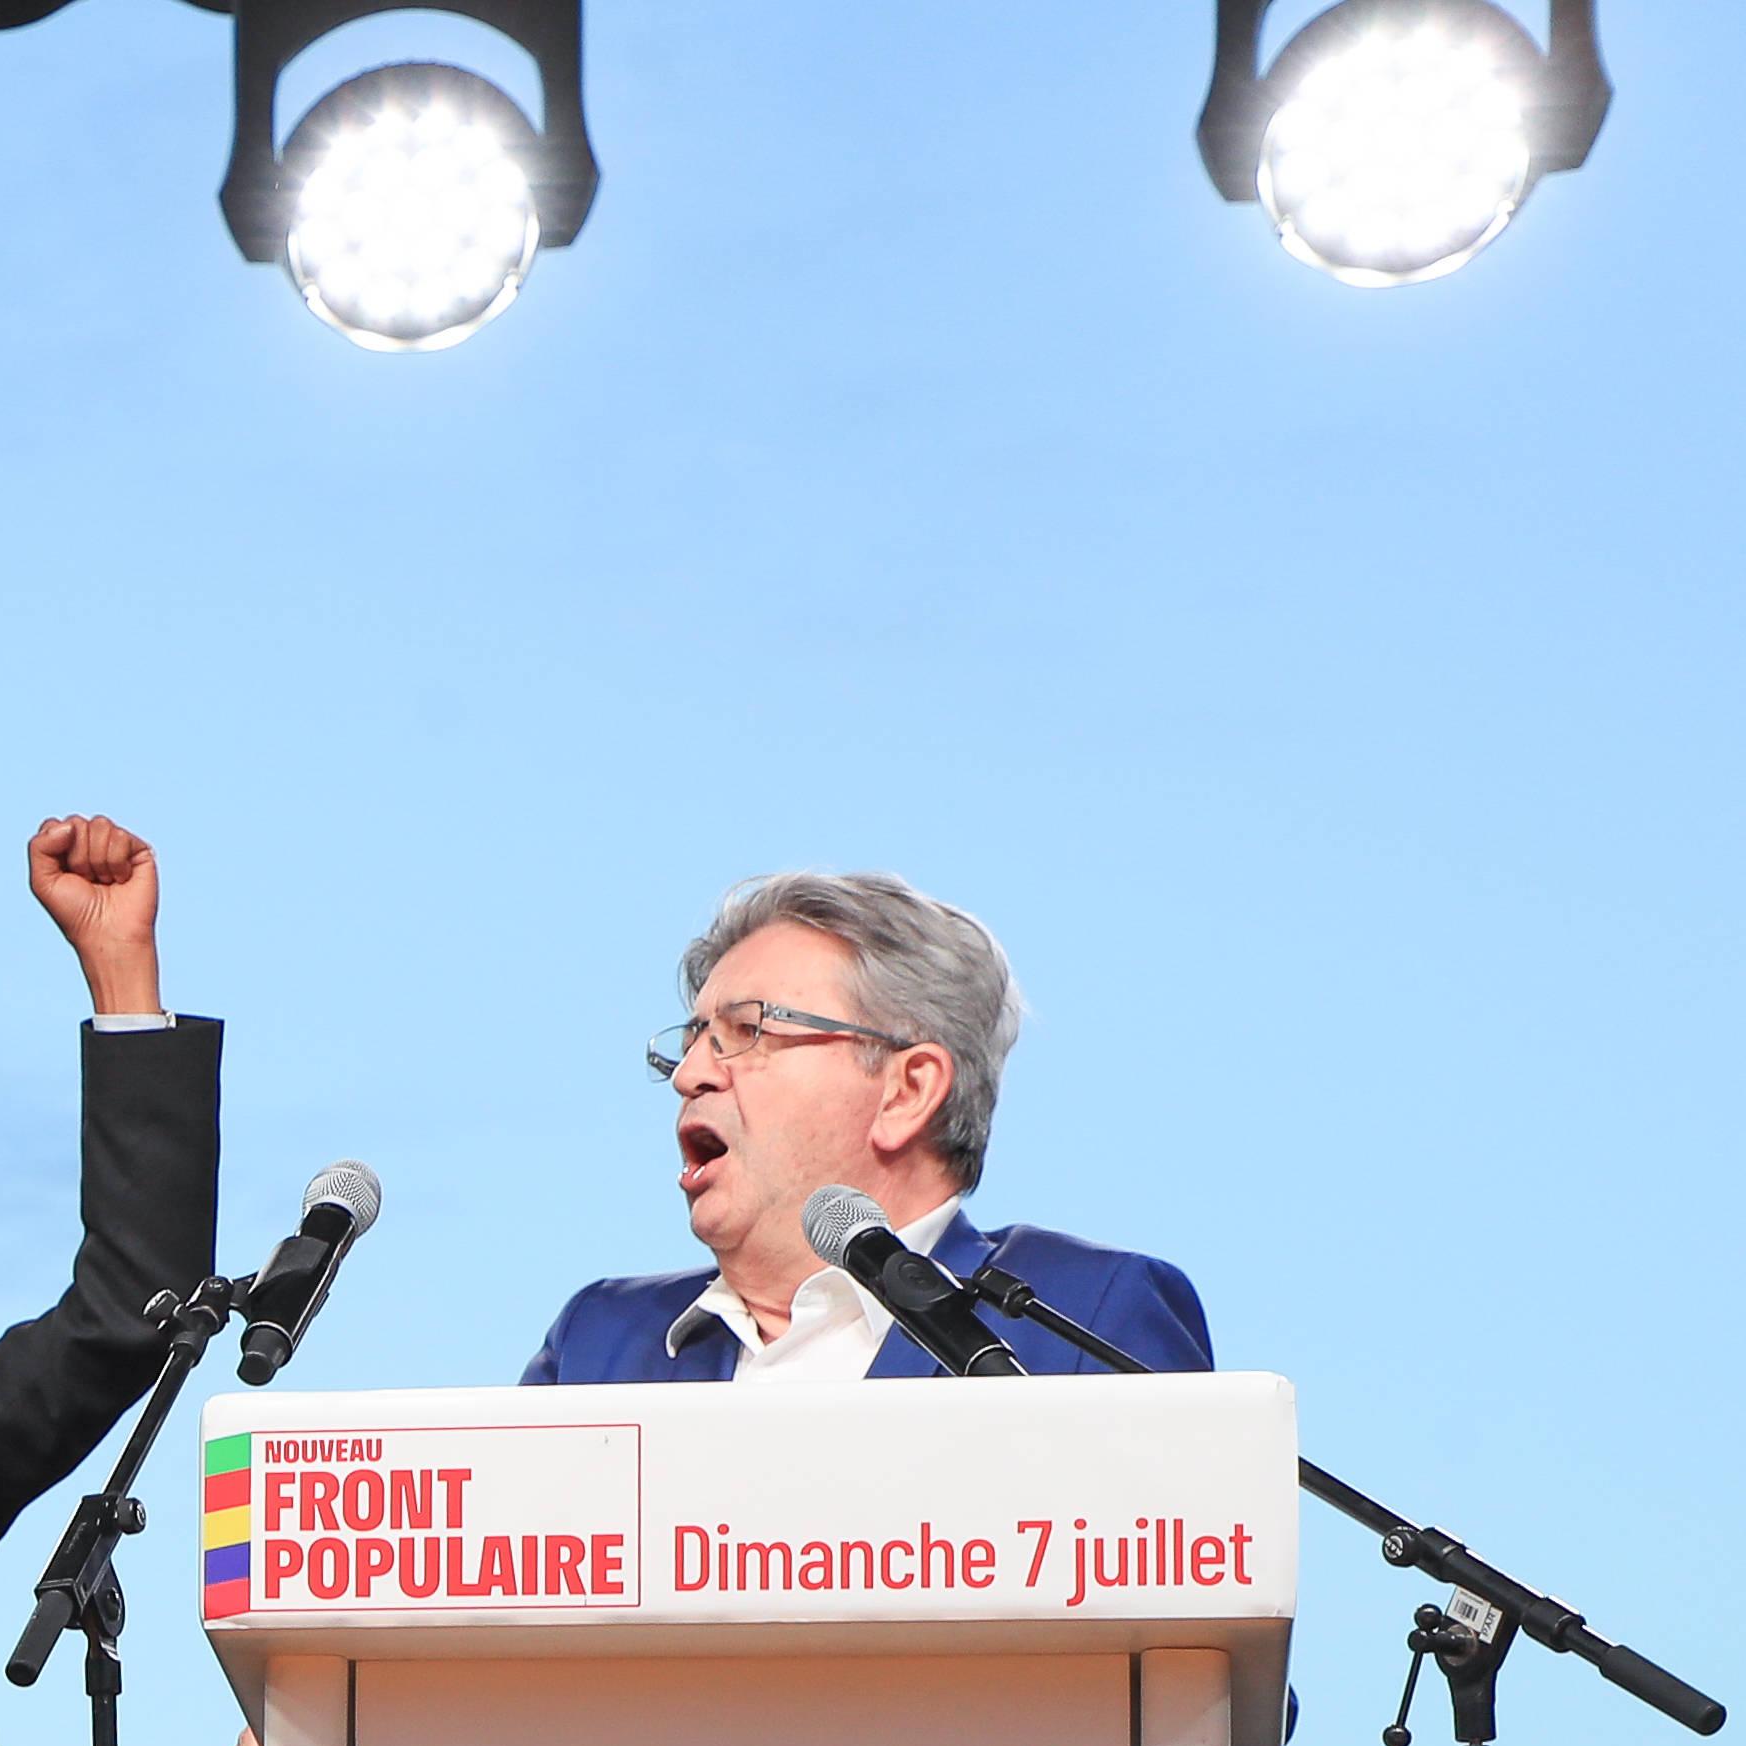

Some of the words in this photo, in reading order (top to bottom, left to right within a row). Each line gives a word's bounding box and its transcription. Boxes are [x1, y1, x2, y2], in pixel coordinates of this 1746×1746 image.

[265, 1438, 383, 1464] NOUVEAU
[264, 1467, 473, 1533] FRONT
[264, 1533, 625, 1601] POPULAIRE
[674, 1521, 996, 1593] Dimanche
[1017, 1519, 1053, 1588] 7
[1066, 1517, 1253, 1608] juillet
